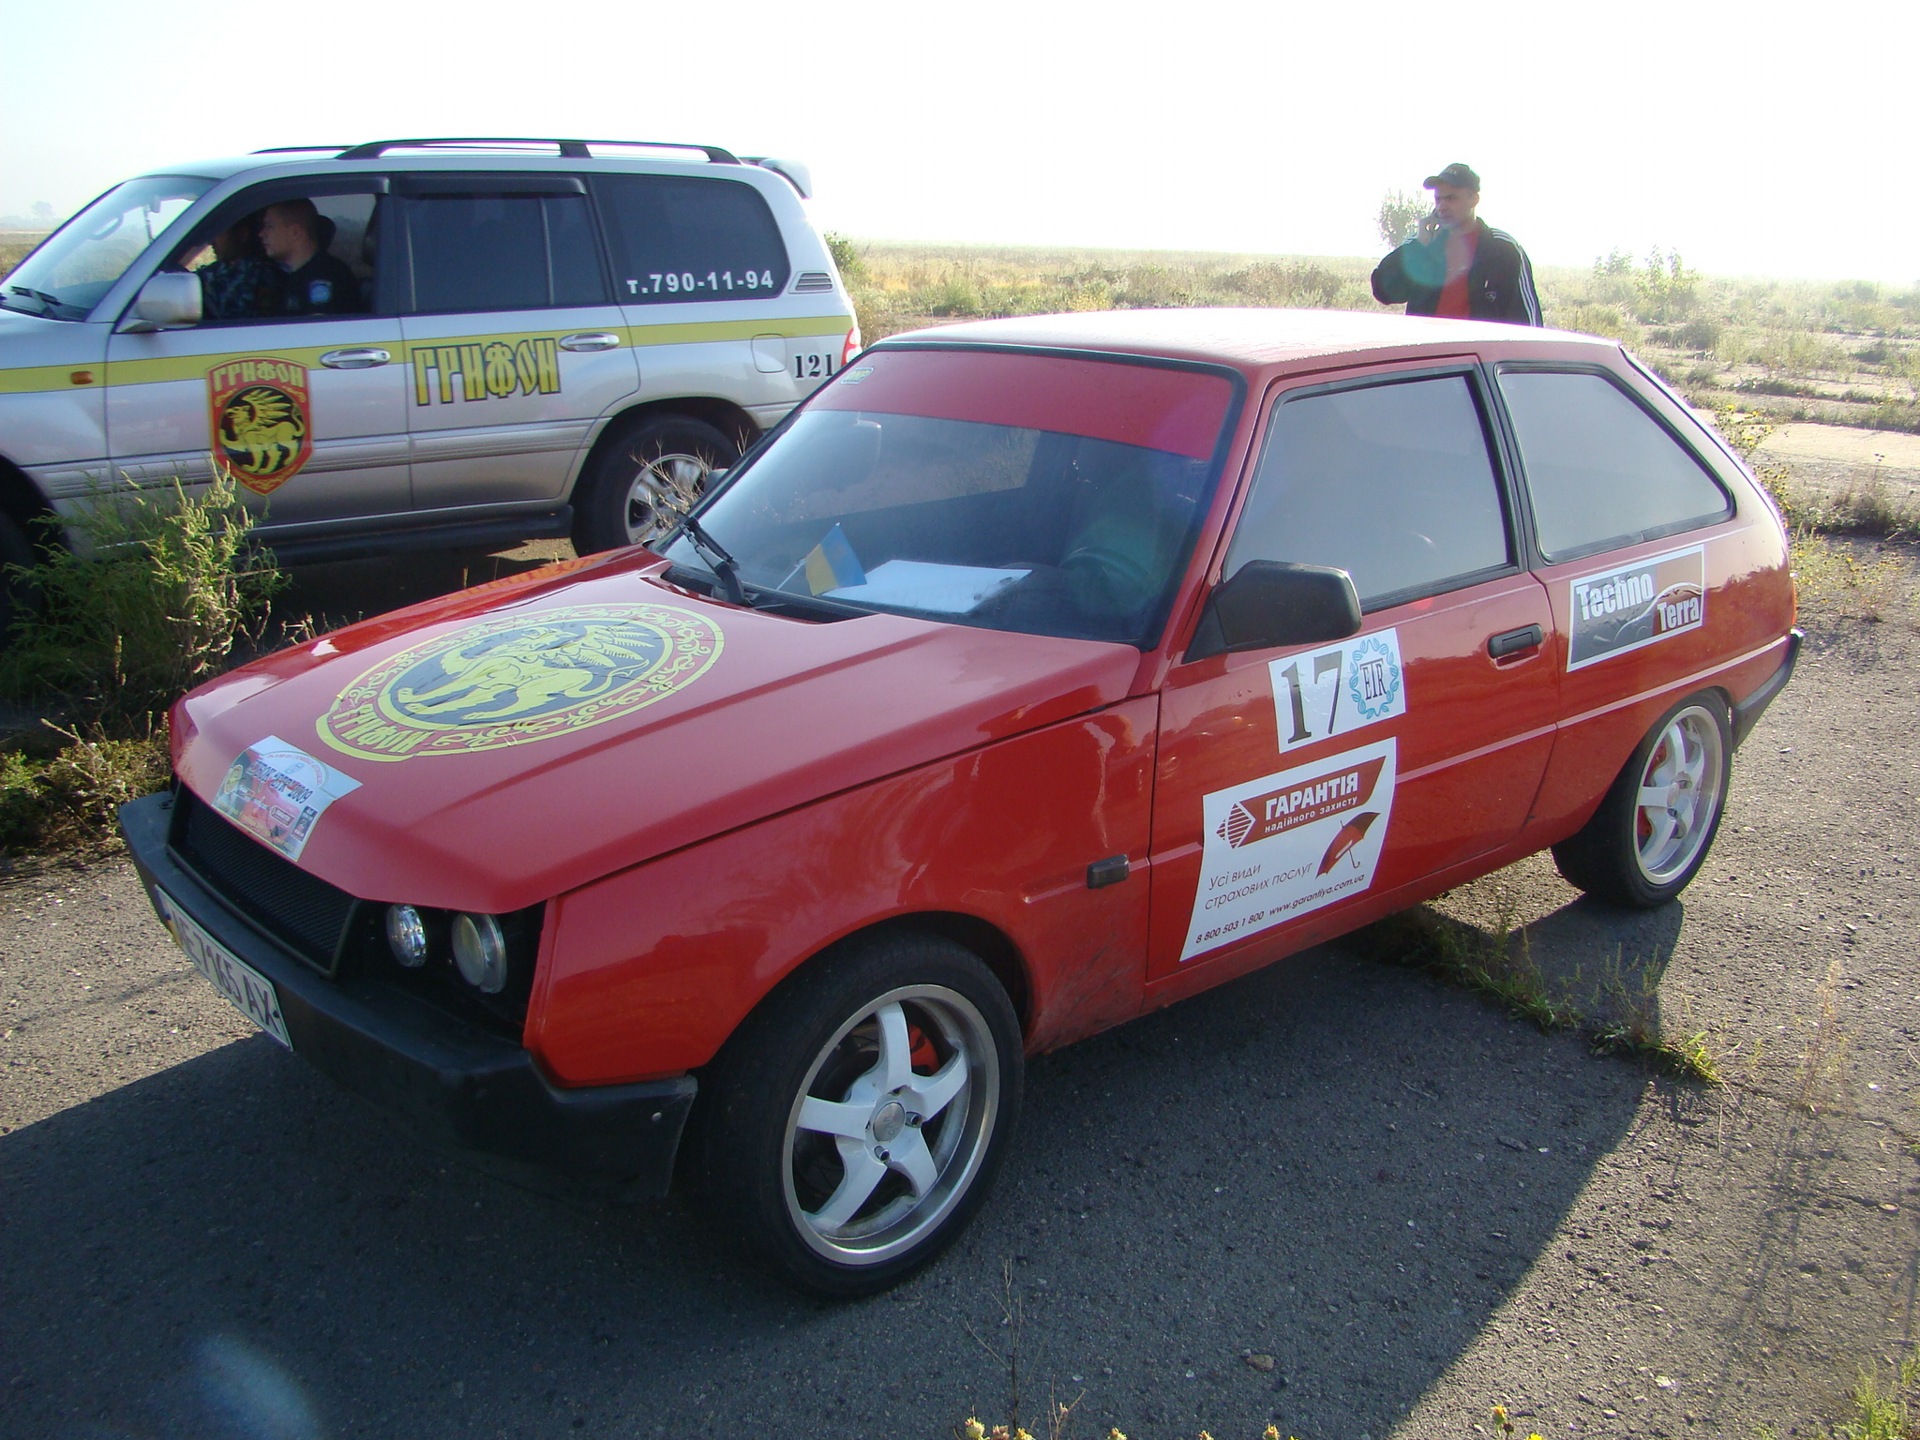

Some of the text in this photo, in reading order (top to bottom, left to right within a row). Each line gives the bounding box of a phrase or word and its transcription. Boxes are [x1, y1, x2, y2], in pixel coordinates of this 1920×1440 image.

[213, 361, 305, 392] ГРИФОН
[411, 337, 561, 407] ГРИФОН
[795, 354, 833, 378] 121
[1575, 573, 1655, 621] Techno
[1657, 597, 1700, 632] Terra
[1281, 650, 1342, 744] 17
[1360, 657, 1387, 700] ETR
[332, 703, 435, 753] ГРИФОН
[1264, 796, 1358, 833] надійного захисту
[1265, 772, 1358, 820] ГАРАНТІЯ
[1204, 862, 1313, 910] страхових послуг
[1208, 864, 1261, 890] Усі види
[1195, 934, 1203, 944] 8
[1203, 927, 1221, 941] 800
[1222, 920, 1239, 934] 503
[1247, 911, 1265, 924] 800
[1269, 874, 1365, 916] www.garantiya.com.ua
[243, 973, 281, 1034] AX
